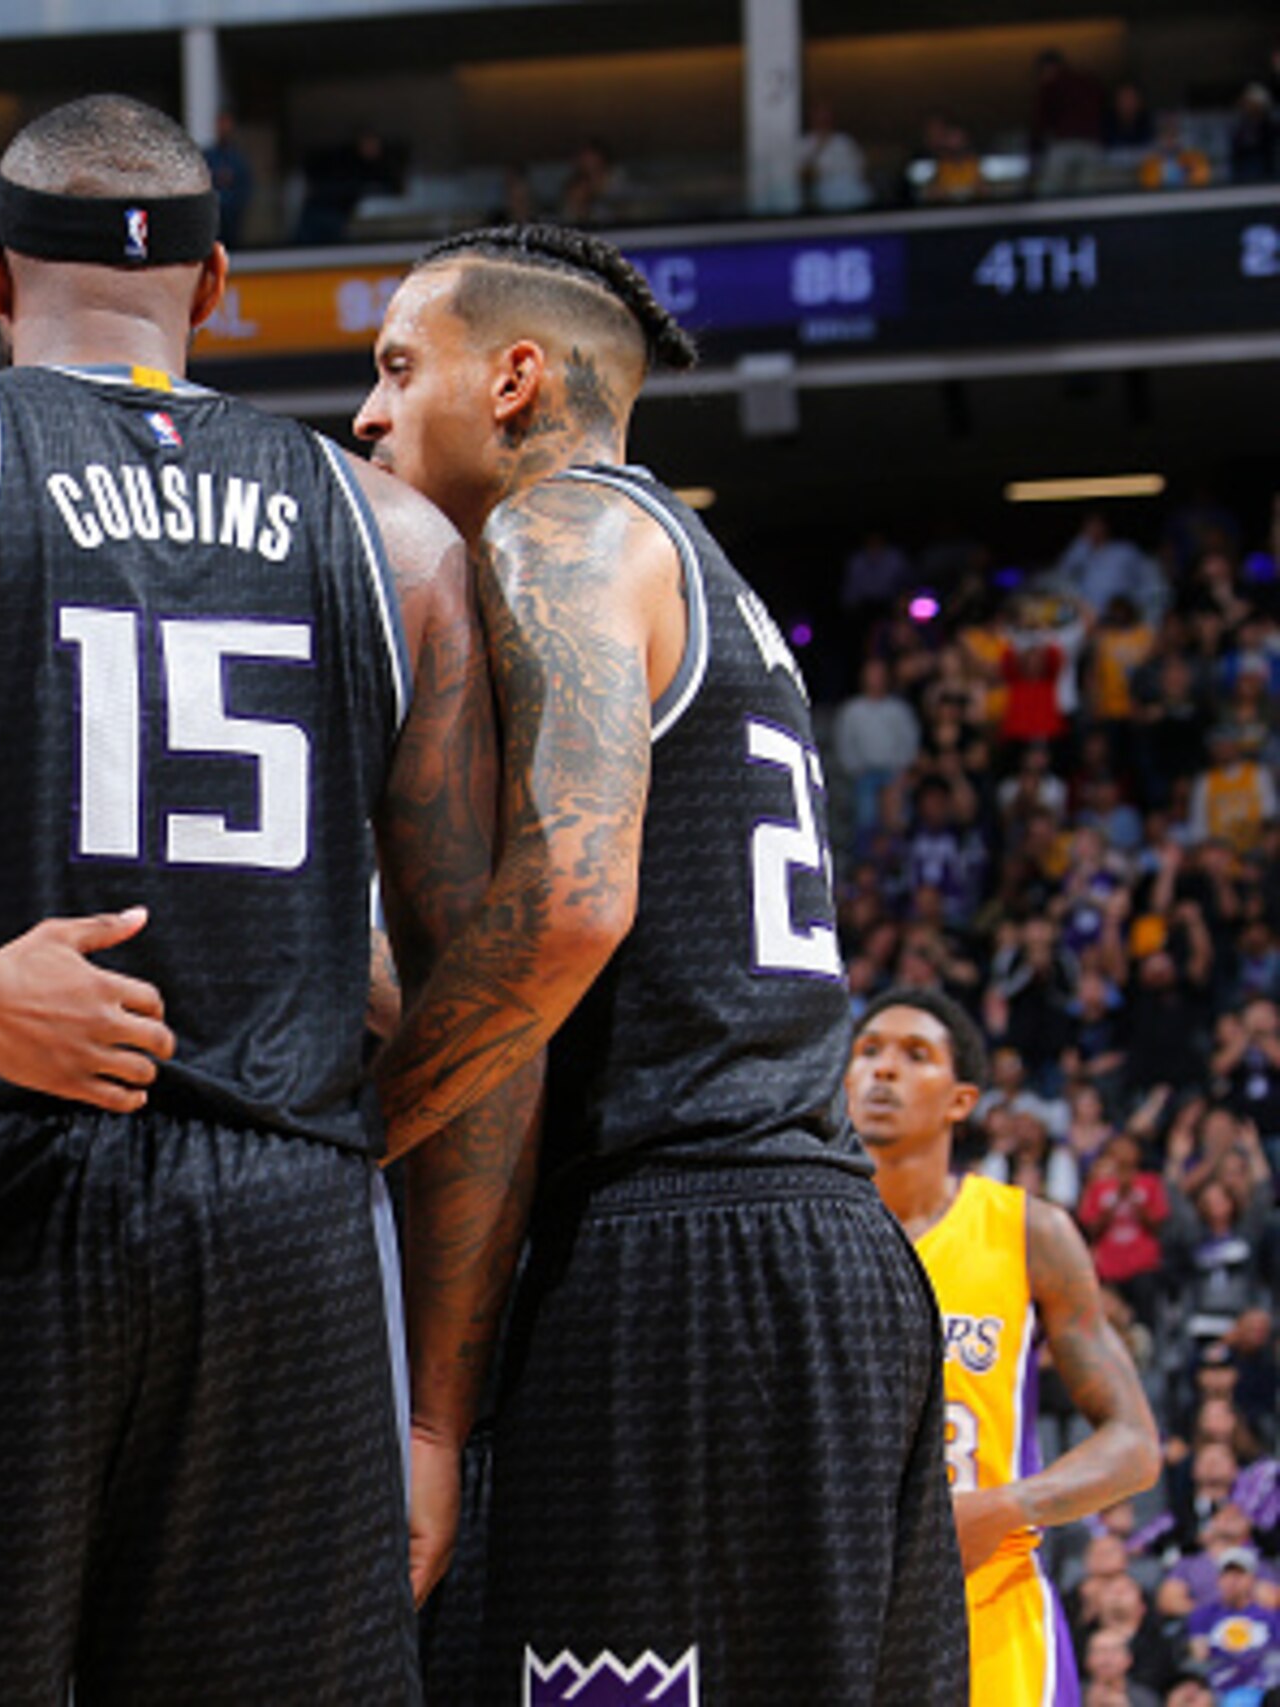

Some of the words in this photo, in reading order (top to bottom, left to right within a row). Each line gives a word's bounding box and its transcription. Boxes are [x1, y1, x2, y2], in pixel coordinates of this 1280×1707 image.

[974, 234, 1099, 293] 4TH
[47, 464, 298, 562] COUSINS
[54, 600, 315, 873] 15
